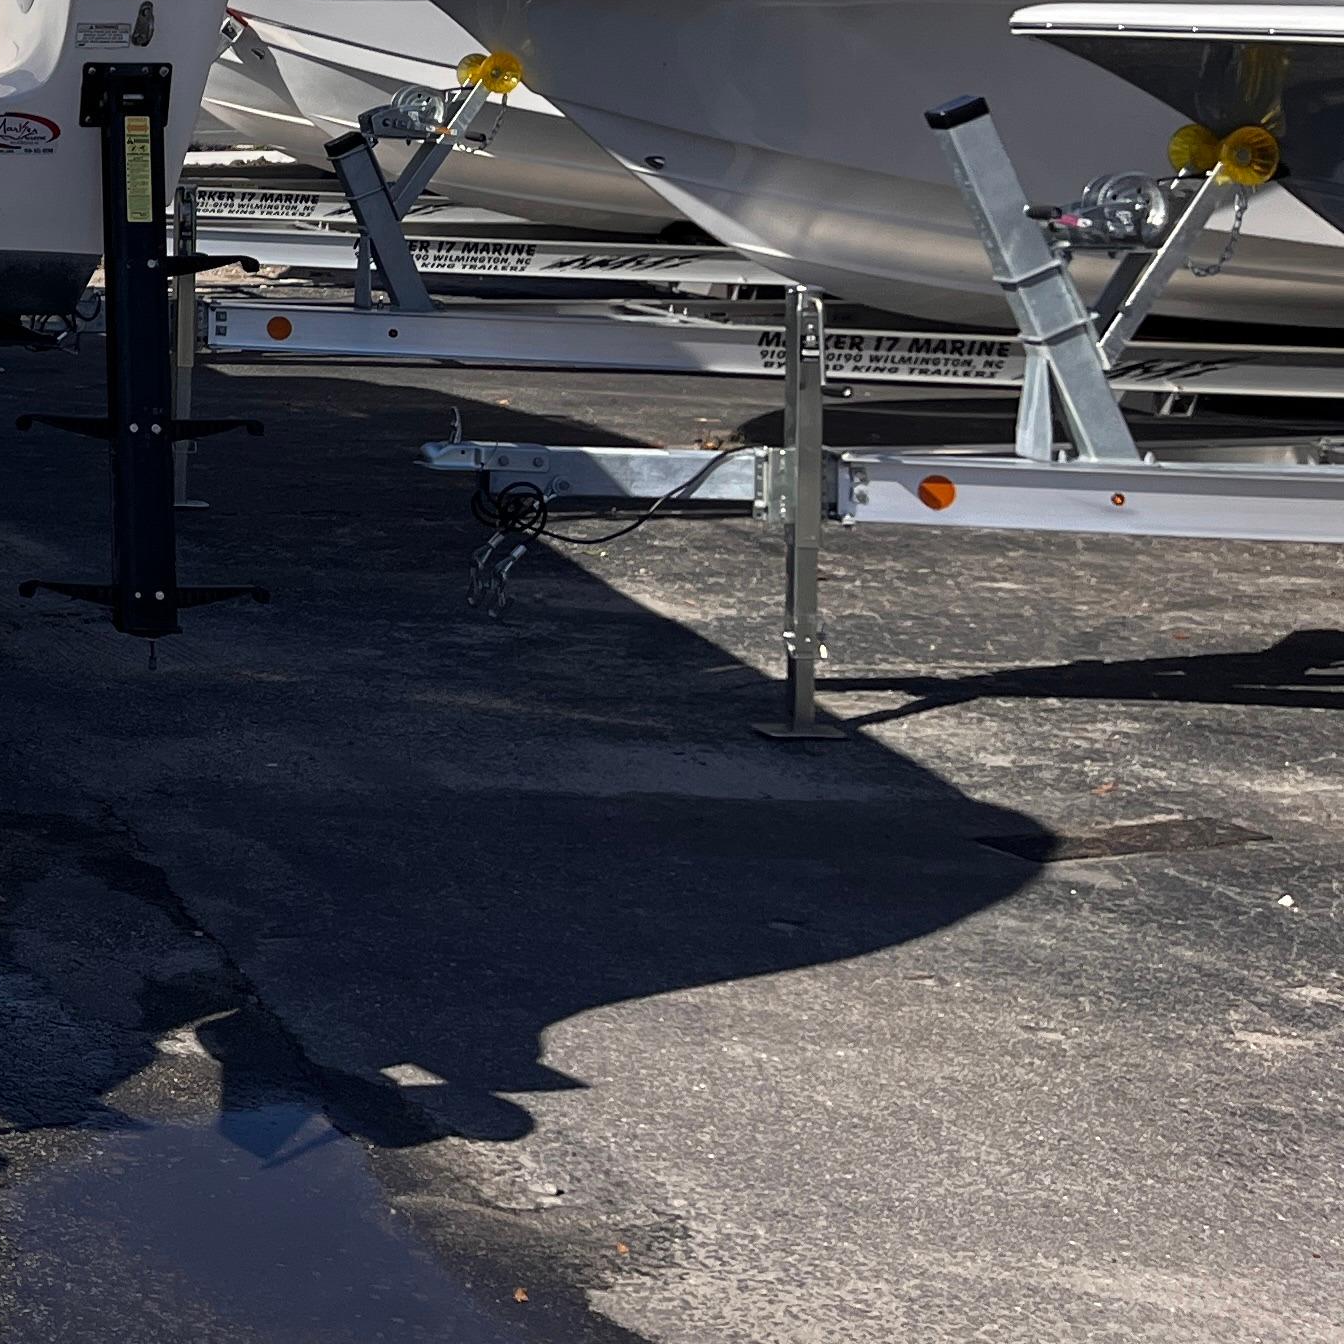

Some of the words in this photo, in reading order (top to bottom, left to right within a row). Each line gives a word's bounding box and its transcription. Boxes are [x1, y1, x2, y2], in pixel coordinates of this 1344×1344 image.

[197, 190, 236, 202] RKER
[239, 191, 256, 202] 17
[259, 193, 320, 205] MARINE
[437, 240, 457, 254] 17
[461, 242, 537, 256] MARINE
[420, 261, 456, 269] KING
[461, 263, 527, 272] TRAILERS
[433, 254, 511, 266] WILMINGTON,
[516, 257, 532, 265] NC
[874, 336, 900, 352] 17
[908, 337, 1013, 358] MARINE
[869, 353, 976, 370] WILMINGTON,
[982, 358, 1006, 370] NC
[851, 364, 900, 374] KING
[907, 366, 1000, 379] TRAILERS
